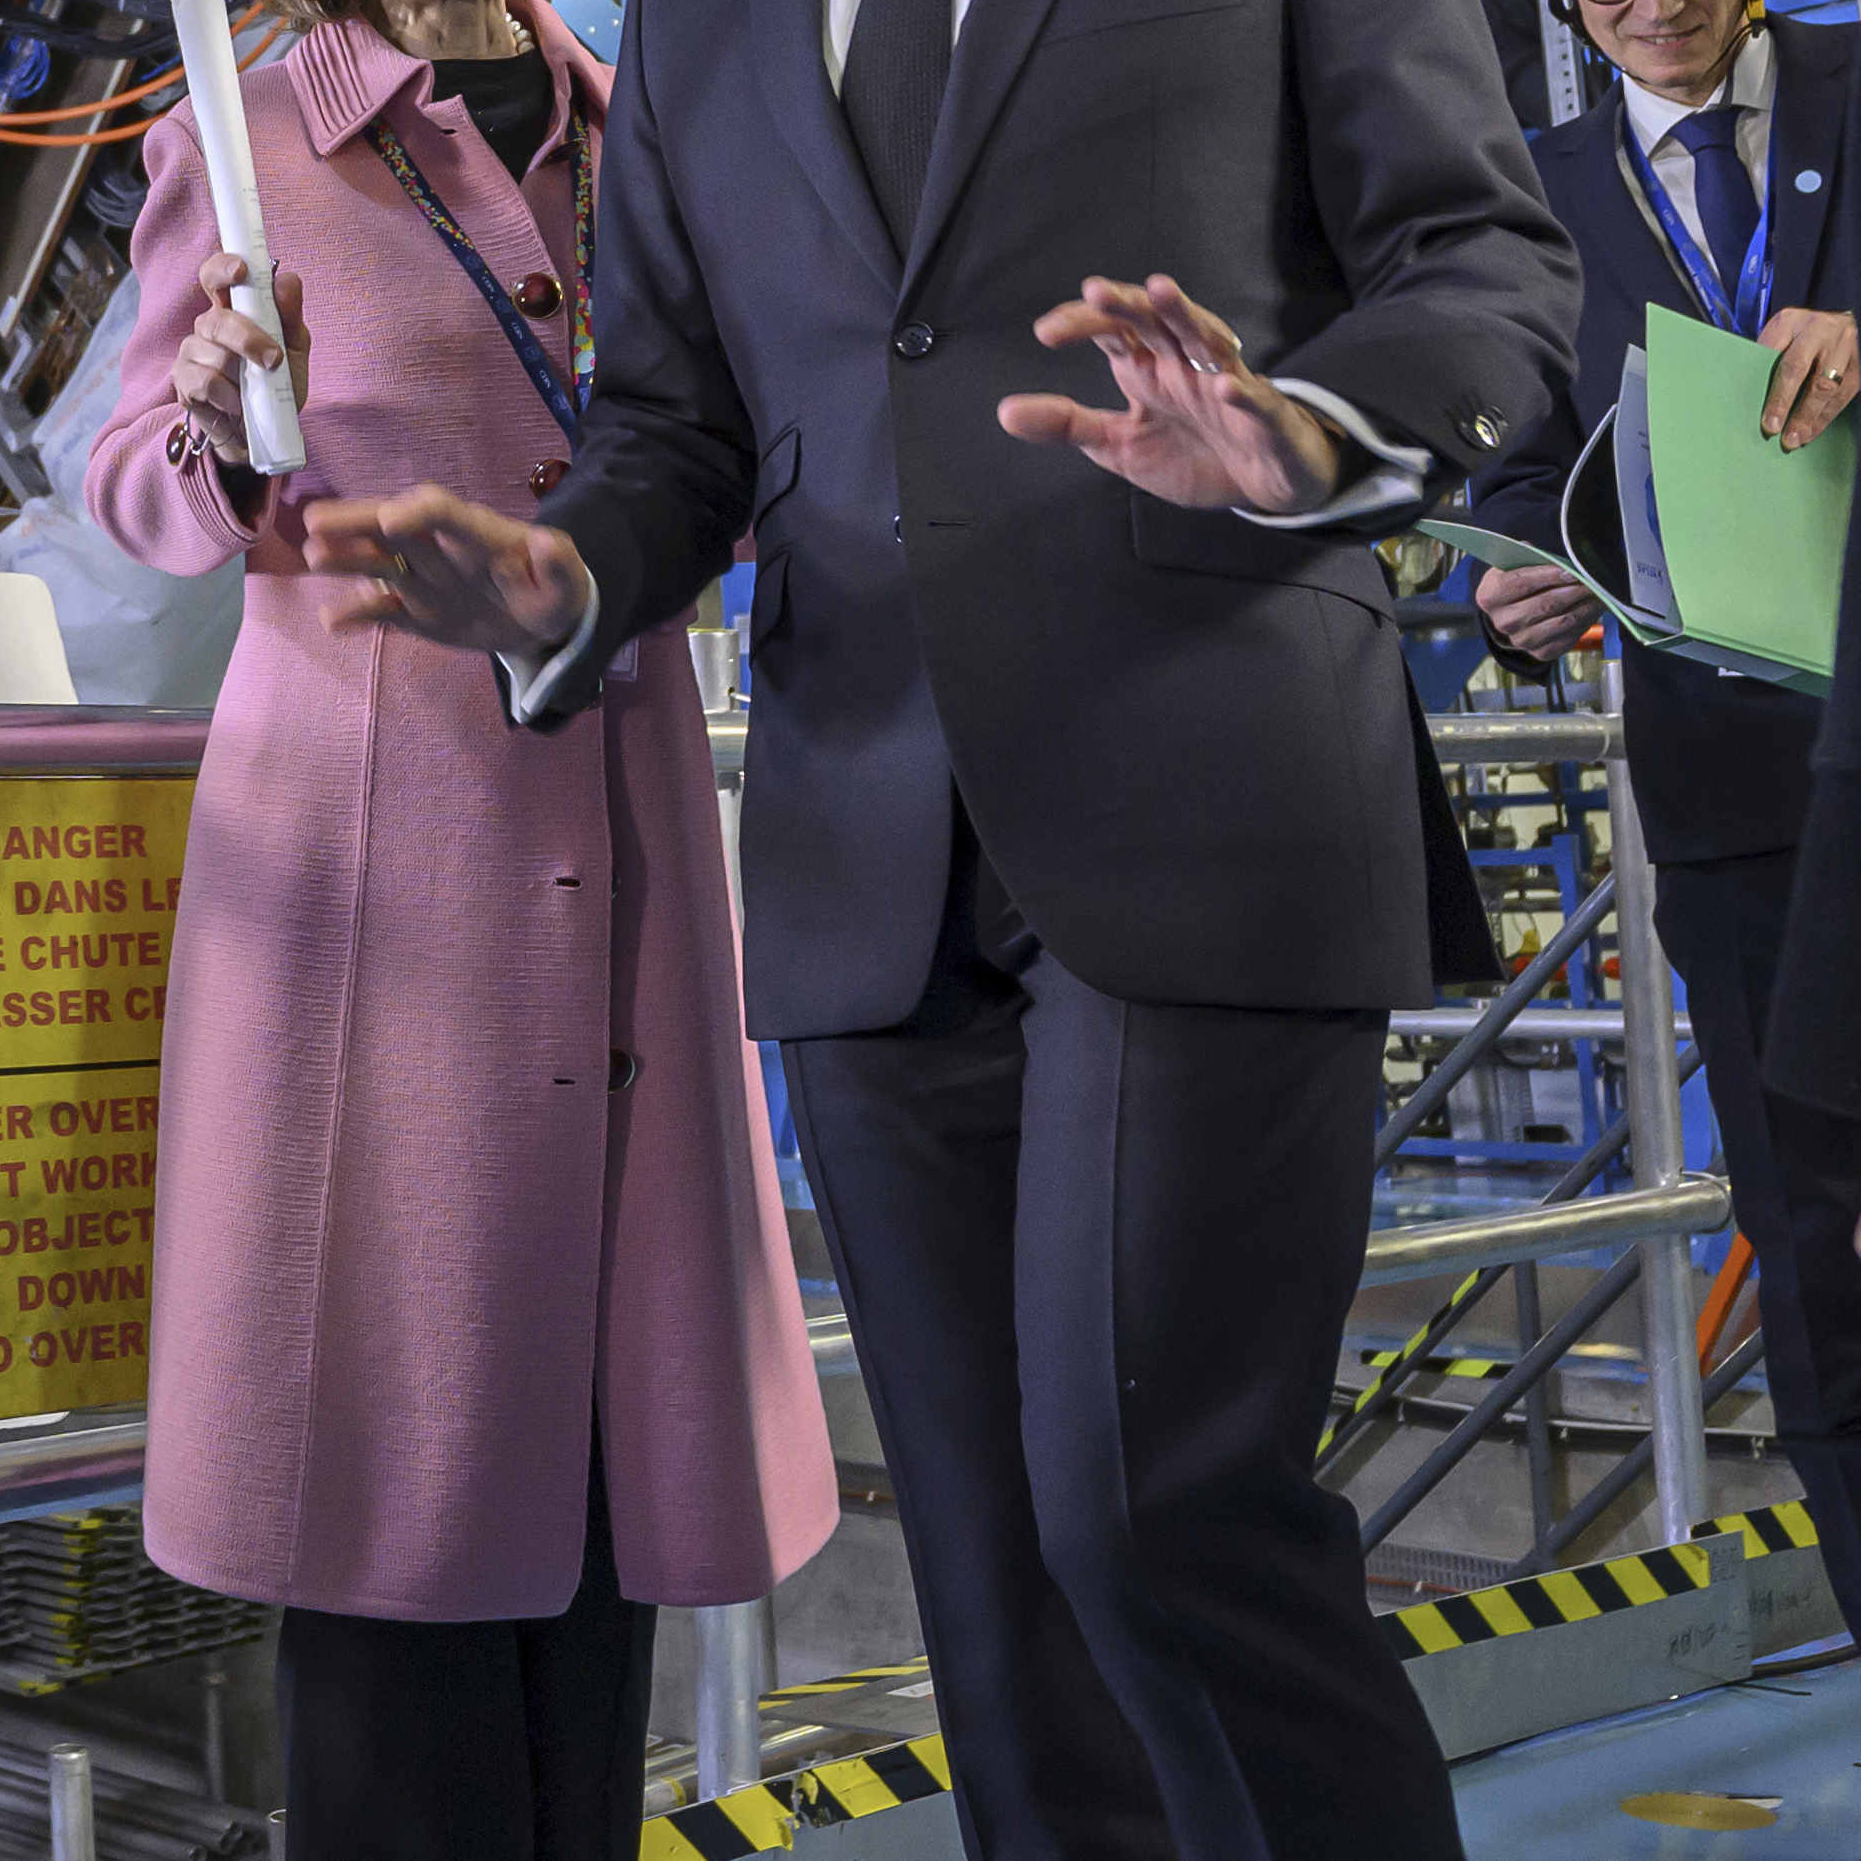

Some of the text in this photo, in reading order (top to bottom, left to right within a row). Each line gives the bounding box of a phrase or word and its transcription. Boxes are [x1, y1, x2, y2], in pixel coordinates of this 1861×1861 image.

[14, 879, 128, 915] DANS
[20, 931, 162, 971] CHUTE
[49, 1096, 159, 1137] OVER
[41, 1152, 157, 1195] WORK
[18, 1264, 145, 1312] DOWN
[29, 1321, 146, 1368] OVER
